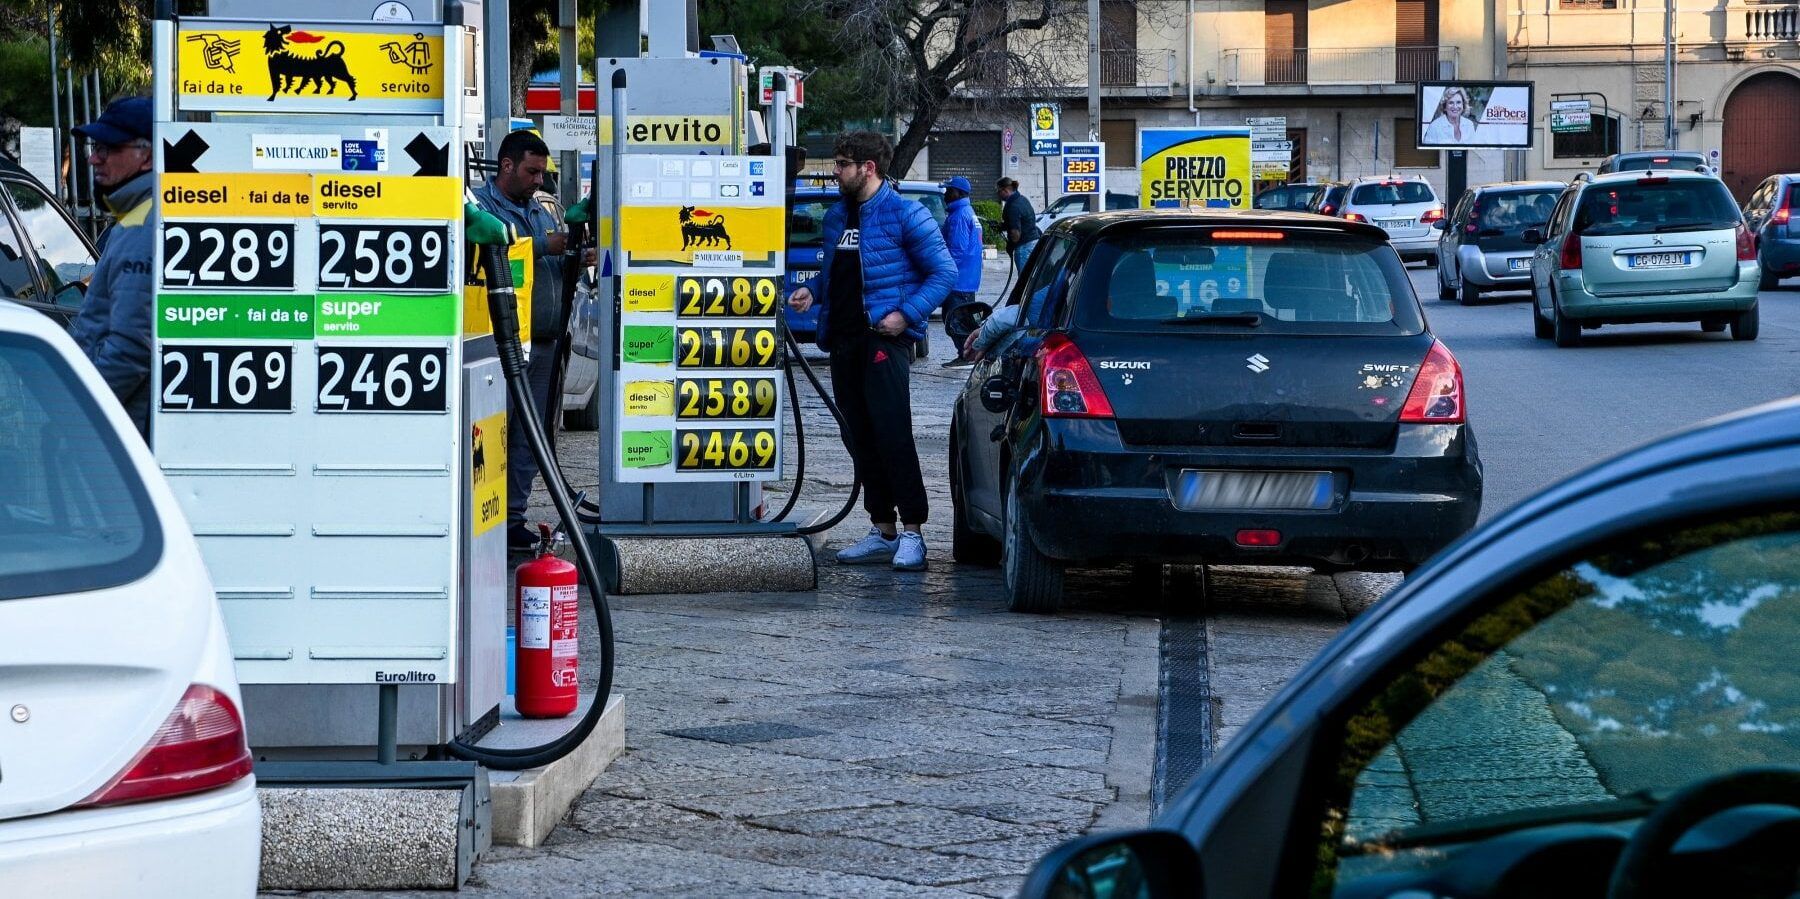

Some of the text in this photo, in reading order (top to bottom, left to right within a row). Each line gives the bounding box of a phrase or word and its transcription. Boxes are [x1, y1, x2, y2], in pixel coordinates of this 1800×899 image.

[184, 80, 243, 94] fai da te
[381, 80, 430, 93] servito
[265, 147, 329, 159] MULTICARD
[1166, 156, 1226, 180] PREZZO
[163, 186, 309, 204] diesel fai da te
[320, 180, 381, 198] diesel
[1150, 179, 1242, 199] SERVITO
[322, 201, 358, 210] servito
[700, 253, 736, 262] MULTICARD
[1635, 253, 1684, 266] CG 079JY
[629, 288, 656, 297] diesel
[681, 277, 776, 315] 2289
[321, 299, 382, 318] super
[165, 306, 309, 326] super fai da te
[323, 321, 360, 331] servito
[628, 341, 654, 350] super
[681, 329, 775, 366] 2169
[1100, 361, 1151, 370] SUZUKI
[1363, 364, 1409, 373] SWIFT
[629, 393, 657, 402] diesel
[680, 379, 774, 417] 2589
[627, 445, 654, 454] super
[681, 431, 774, 467] 2469
[481, 490, 500, 523] servito
[375, 671, 436, 682] Euro/litro
